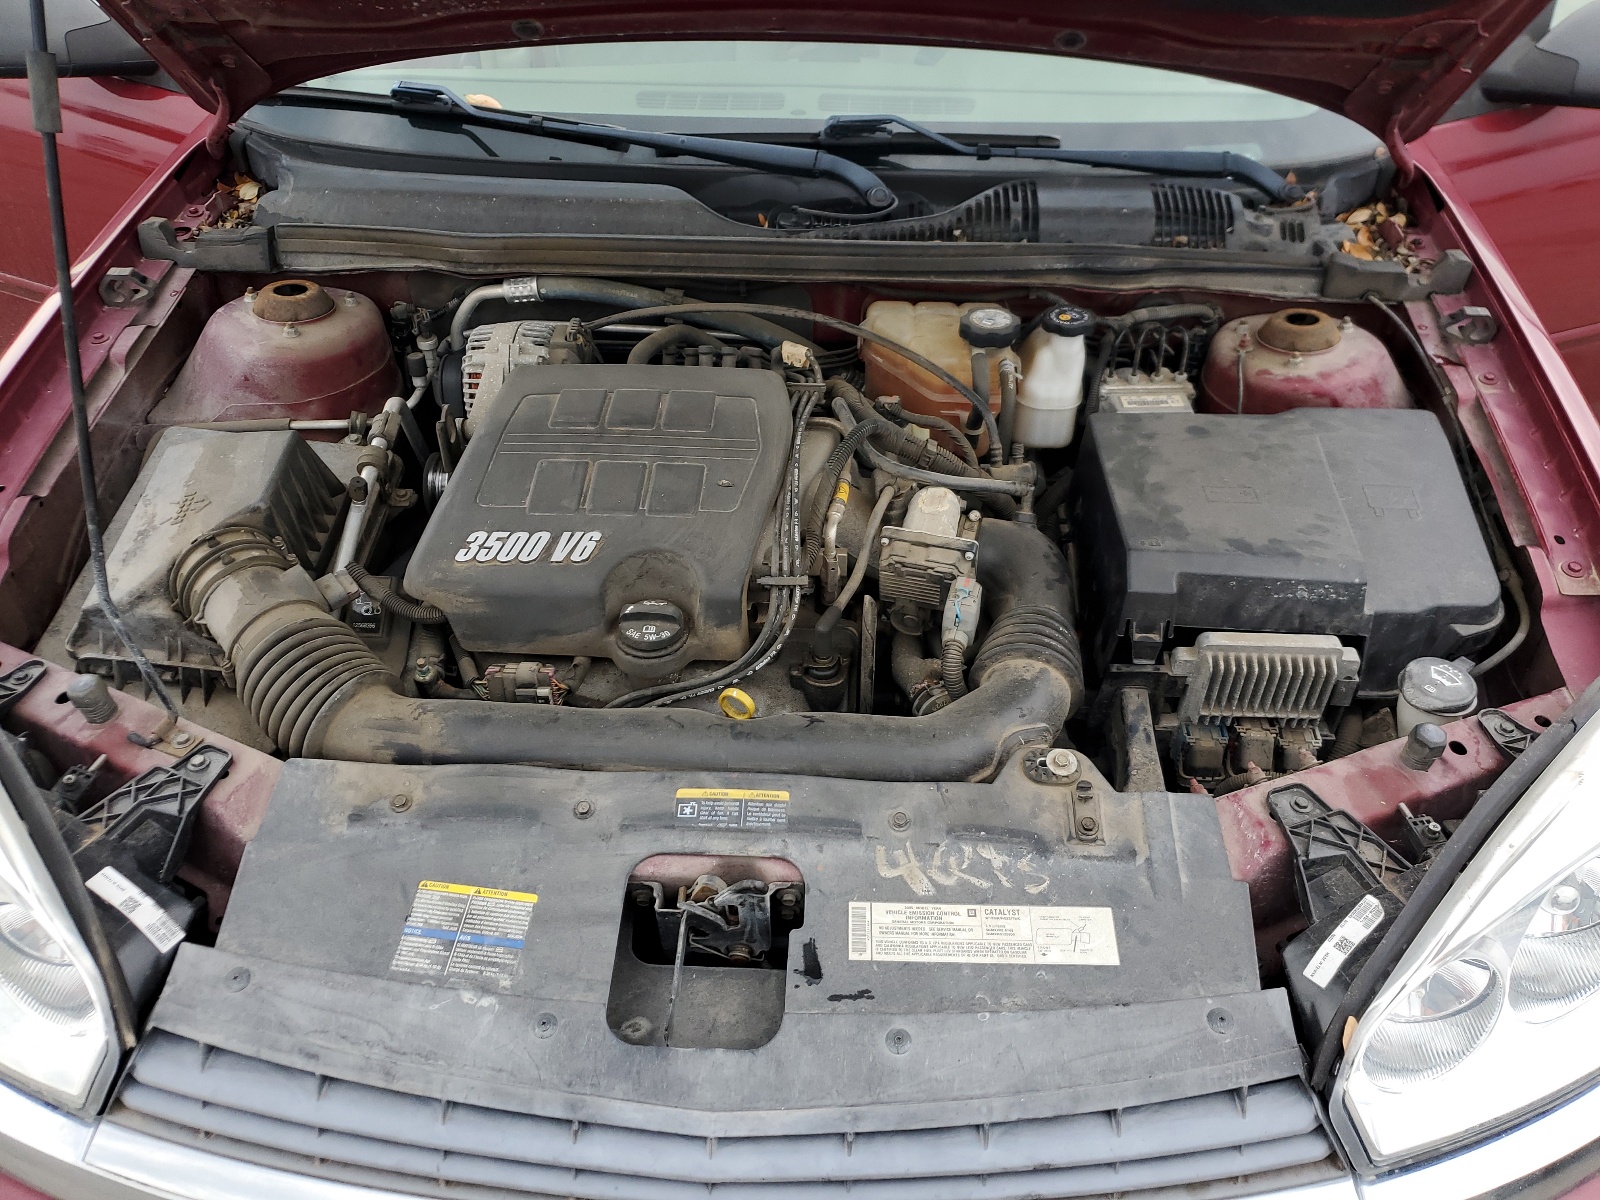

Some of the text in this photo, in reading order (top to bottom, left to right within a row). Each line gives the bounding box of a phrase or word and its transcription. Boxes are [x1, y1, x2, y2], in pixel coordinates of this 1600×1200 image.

[454, 530, 603, 563] 3500 V6
[626, 628, 671, 640] SAE 5W-30
[428, 882, 450, 890] CAUTION
[984, 908, 1020, 916] CATALYST
